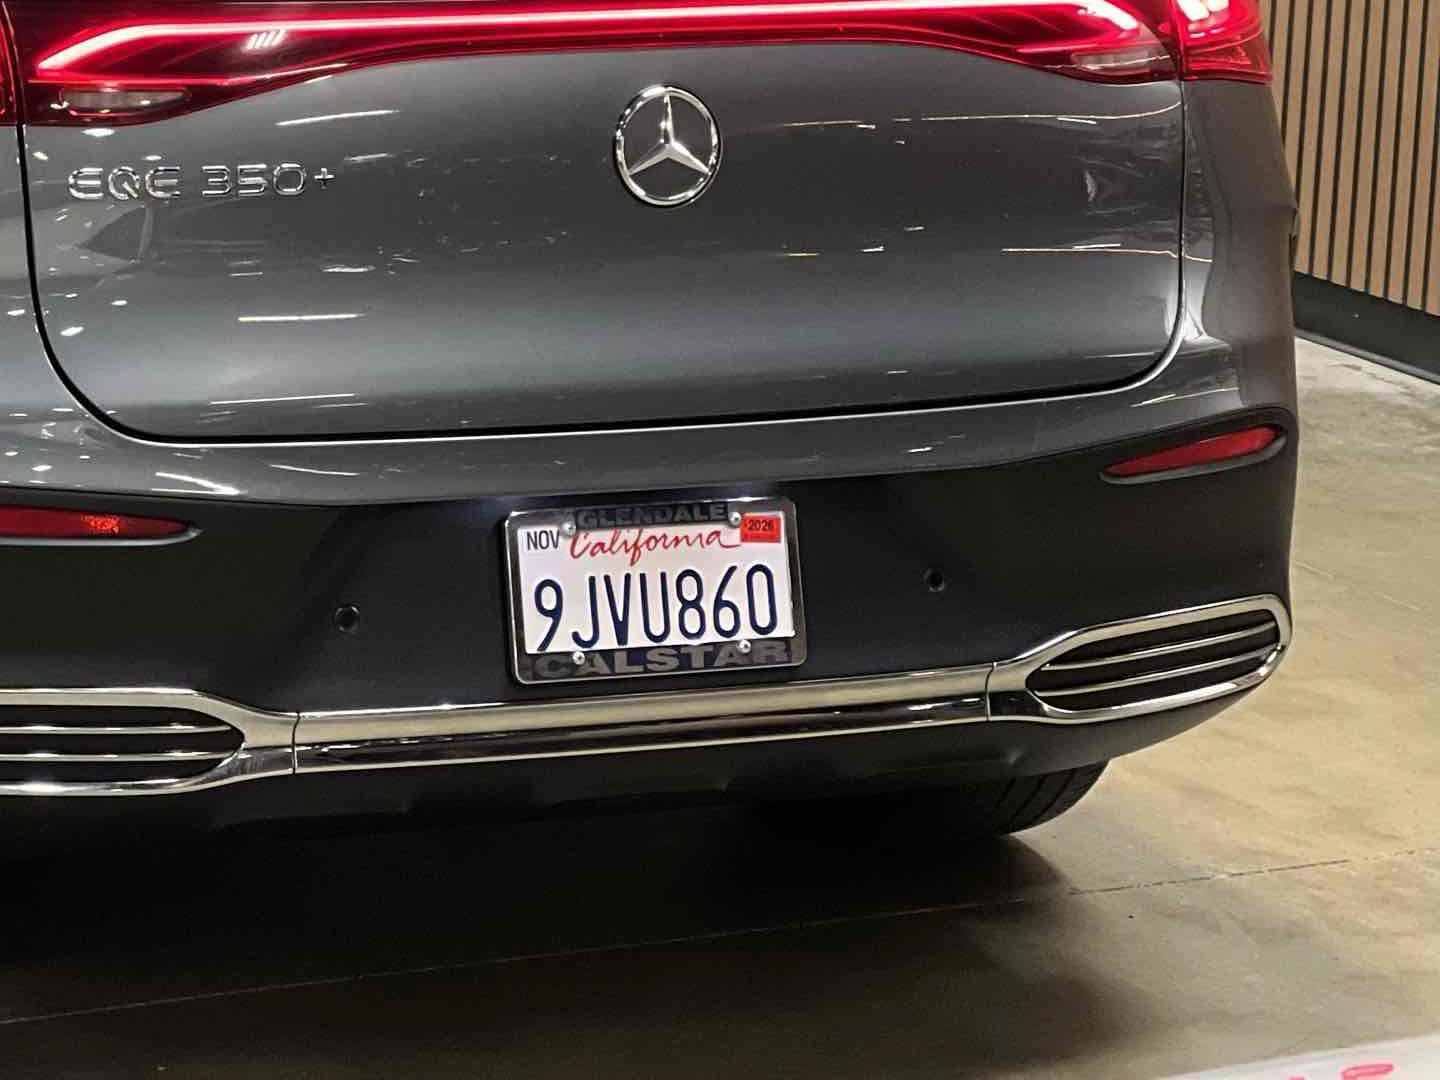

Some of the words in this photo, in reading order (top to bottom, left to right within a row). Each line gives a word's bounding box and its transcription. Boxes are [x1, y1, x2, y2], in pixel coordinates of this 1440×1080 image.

[68, 165, 181, 200] EQE
[201, 162, 336, 198] 350+
[578, 501, 727, 528] GLENDALE
[526, 529, 559, 551] NOV
[569, 528, 741, 567] California
[534, 563, 778, 652] 9JVU860
[534, 640, 789, 679] CALSTAR
